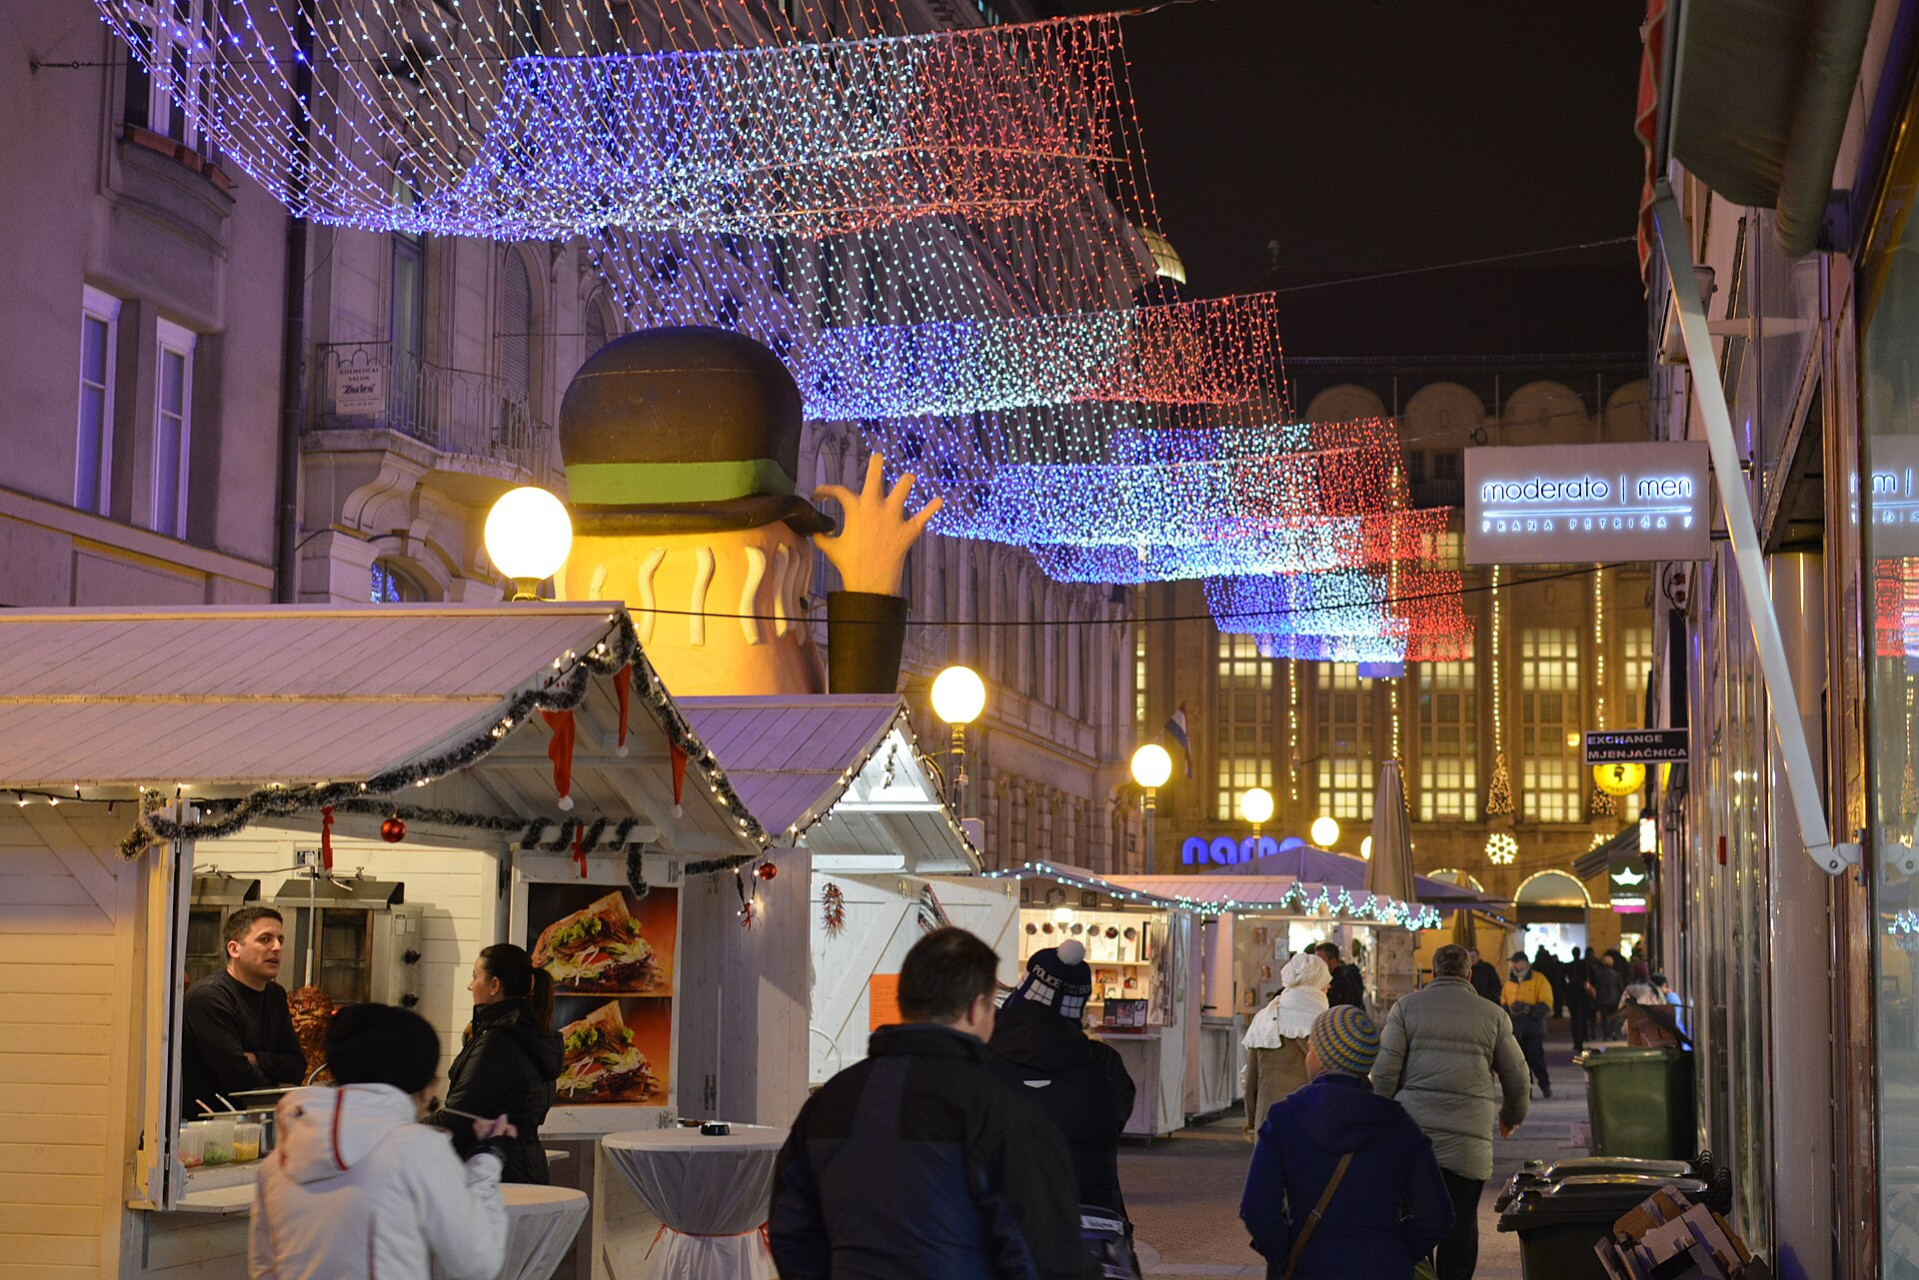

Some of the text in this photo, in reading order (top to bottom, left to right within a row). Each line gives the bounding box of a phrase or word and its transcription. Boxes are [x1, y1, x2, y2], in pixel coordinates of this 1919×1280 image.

[1482, 476, 1692, 502] moderato men
[1587, 734, 1663, 745] EXCHANGE
[1588, 748, 1687, 760] MJENJAČNICA
[1032, 964, 1063, 989] POLICE
